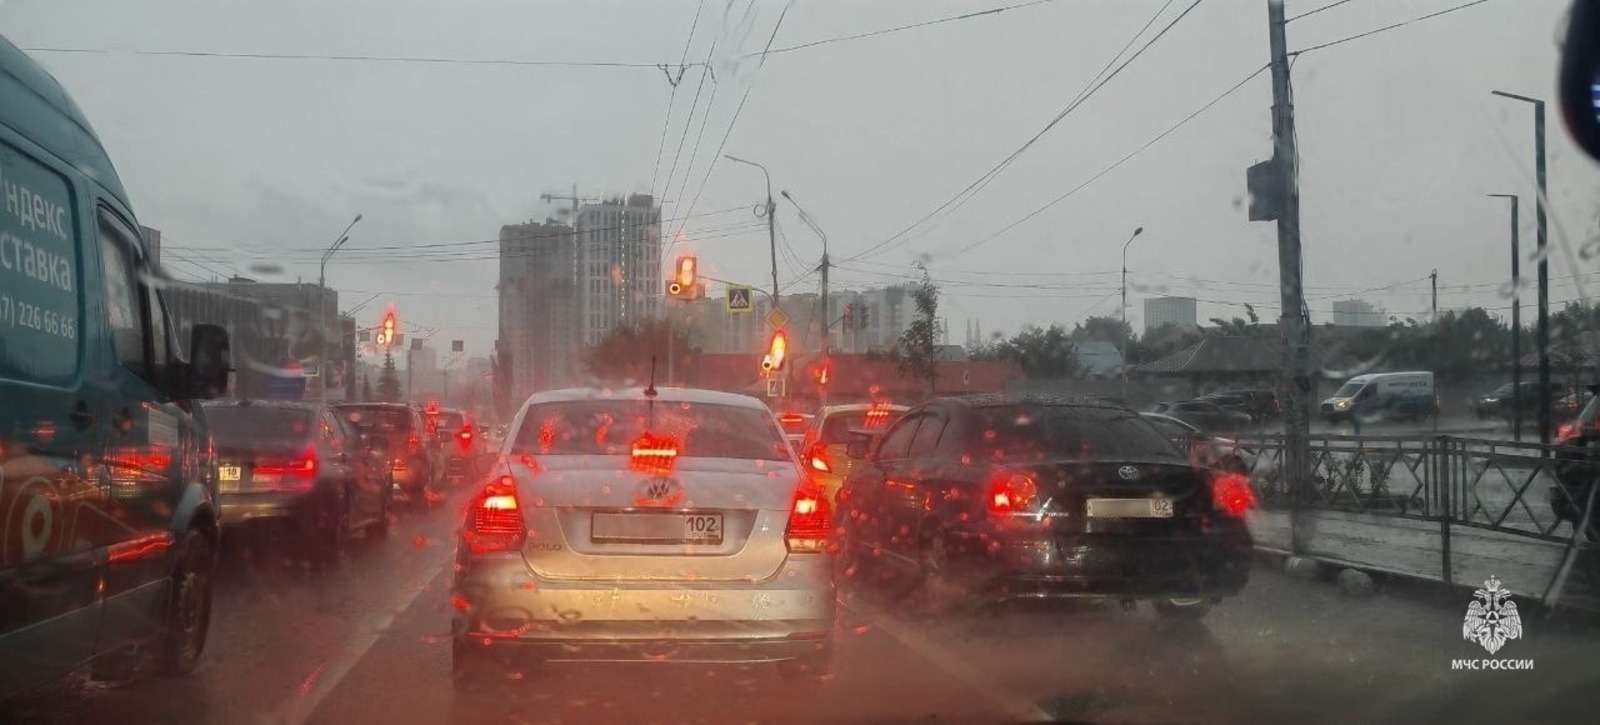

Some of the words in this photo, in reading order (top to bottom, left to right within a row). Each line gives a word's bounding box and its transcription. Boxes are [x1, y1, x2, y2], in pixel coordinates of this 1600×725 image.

[0, 176, 68, 240] ндекс
[19, 301, 41, 330] 226
[44, 310, 58, 336] 66
[61, 315, 75, 340] 66
[686, 517, 716, 532] 102
